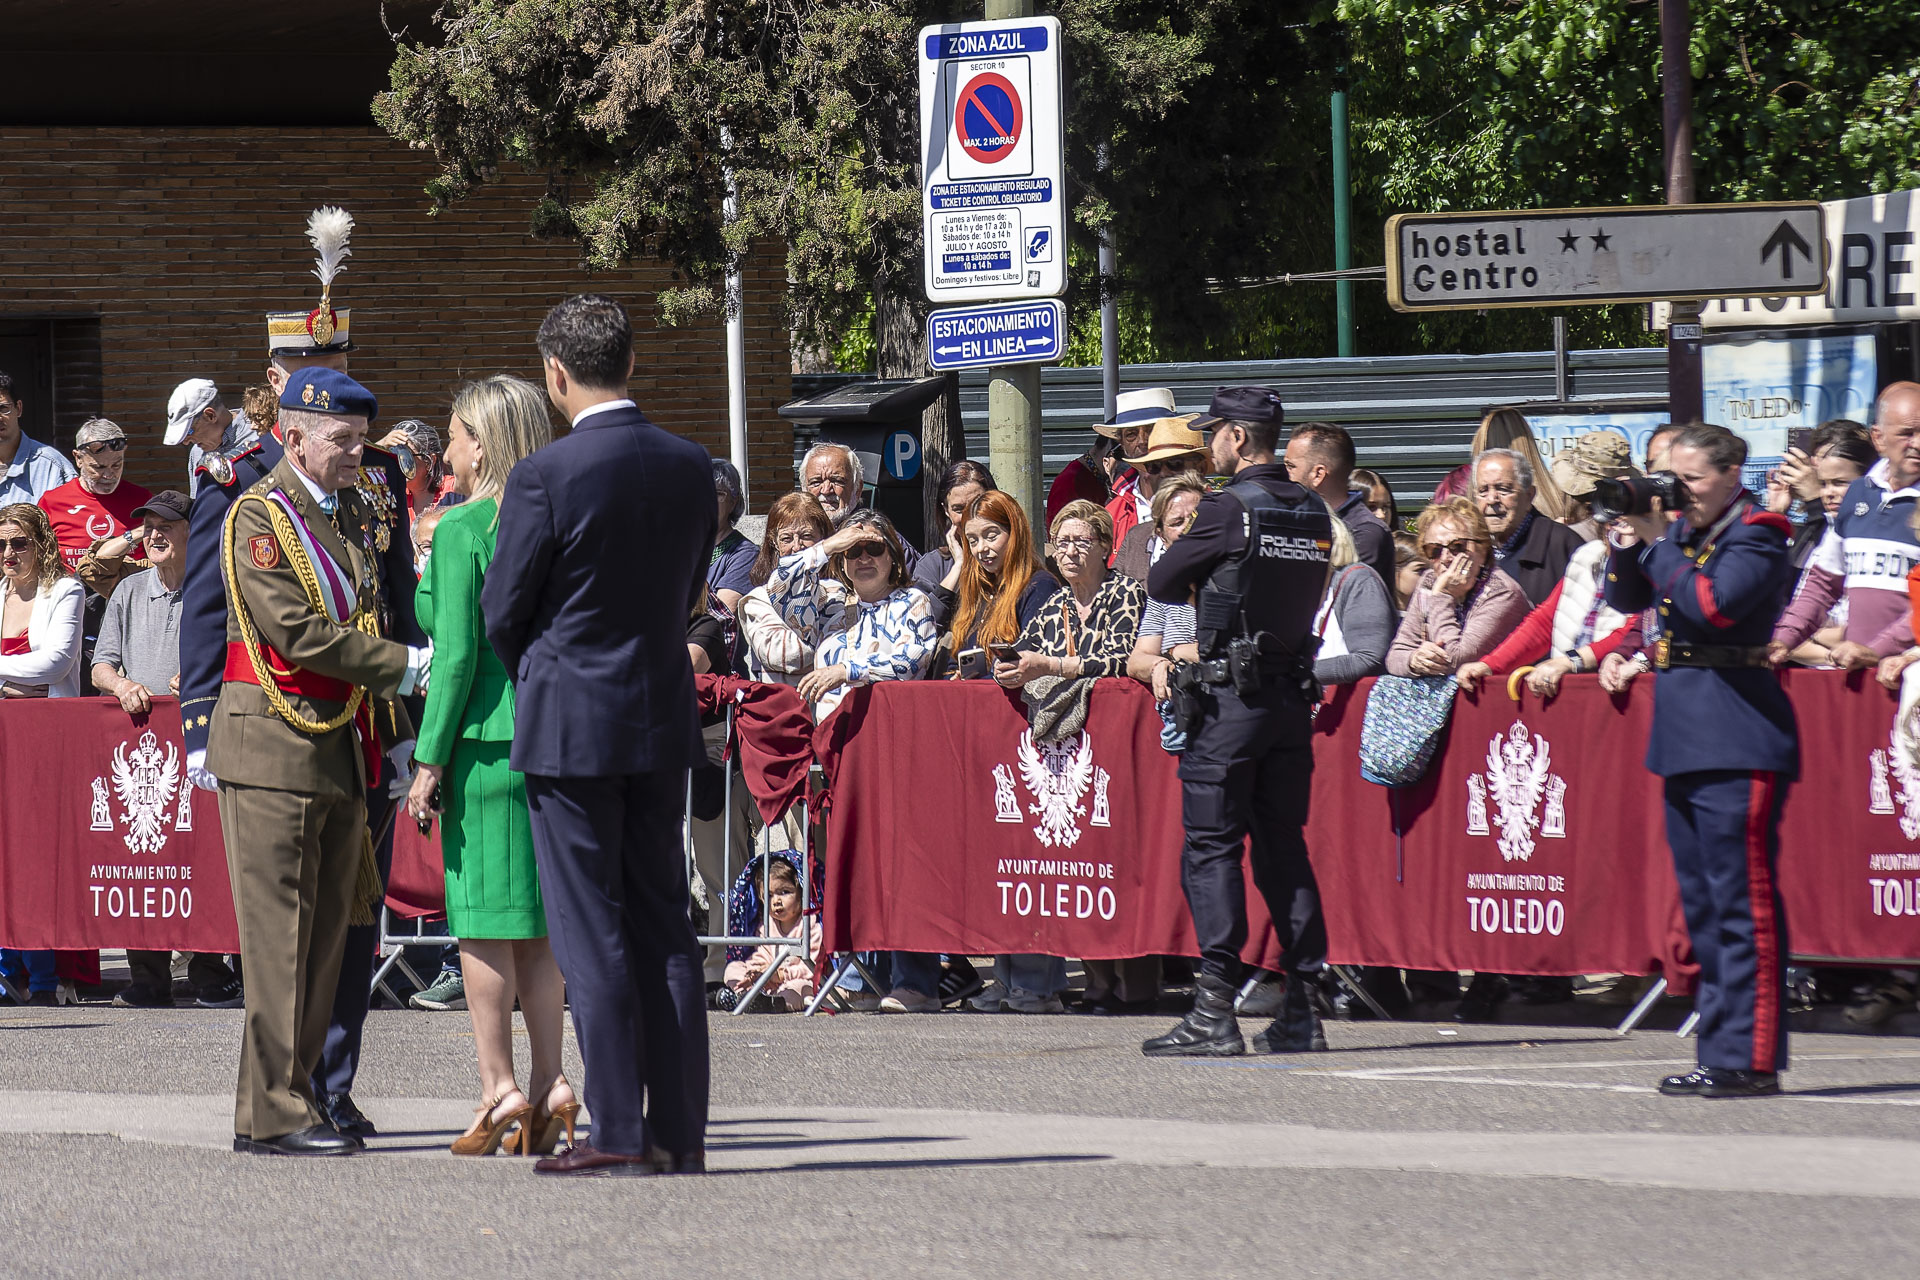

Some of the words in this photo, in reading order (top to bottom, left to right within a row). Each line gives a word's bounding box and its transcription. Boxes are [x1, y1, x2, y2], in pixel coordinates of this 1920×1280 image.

[949, 36, 987, 54] ZONA
[989, 32, 1025, 51] AZUL
[970, 63, 996, 71] SECTOR
[964, 138, 982, 147] MAX.
[983, 137, 988, 146] 2
[989, 136, 1015, 145] HORAS
[933, 186, 949, 196] ZONA
[950, 185, 958, 194] DE
[959, 181, 1015, 194] ESTACIONAMIENTO
[1016, 179, 1049, 190] REGULADO
[941, 197, 961, 207] TICKET
[962, 196, 971, 206] DE
[972, 194, 1001, 205] CONTROL
[1002, 192, 1042, 203] OBLIGATORIO
[945, 215, 964, 224] Lunes
[971, 214, 995, 222] Viernes
[997, 212, 1007, 221] de:
[955, 224, 963, 232] 14
[970, 225, 973, 233] y
[975, 223, 983, 231] de
[985, 222, 992, 230] 17
[999, 221, 1006, 229] 20
[972, 231, 981, 240] de:
[983, 231, 991, 239] 10
[1412, 227, 1526, 258] hostal
[945, 242, 967, 251] JULIO
[969, 242, 974, 250] Y
[976, 241, 1007, 249] AGOSTO
[944, 254, 964, 263] Lunes
[1000, 251, 1010, 259] de:
[963, 262, 971, 270] 10
[978, 261, 986, 269] 14
[936, 275, 967, 284] Domingos
[974, 273, 1001, 282] festivos:
[1002, 272, 1019, 280] Libre
[1414, 262, 1538, 292] Centro
[935, 310, 1051, 338] ESTACIONAMIENTO
[962, 340, 981, 358] EN
[985, 336, 1026, 356] LINEA
[895, 433, 916, 477] P
[1260, 534, 1319, 550] POLICIA
[1259, 546, 1329, 562] NACIONAL
[90, 865, 177, 879] AYUNTAMIENTO
[181, 866, 192, 880] DE
[997, 859, 1094, 878] AYUNTAMIENTO
[1098, 863, 1114, 879] DE
[1467, 873, 1545, 891] AYUNTAMIENTO
[1547, 875, 1565, 892] DE
[90, 886, 192, 919] TOLEDO
[997, 881, 1116, 921] TOLEDO
[1466, 897, 1565, 936] TOLEDO
